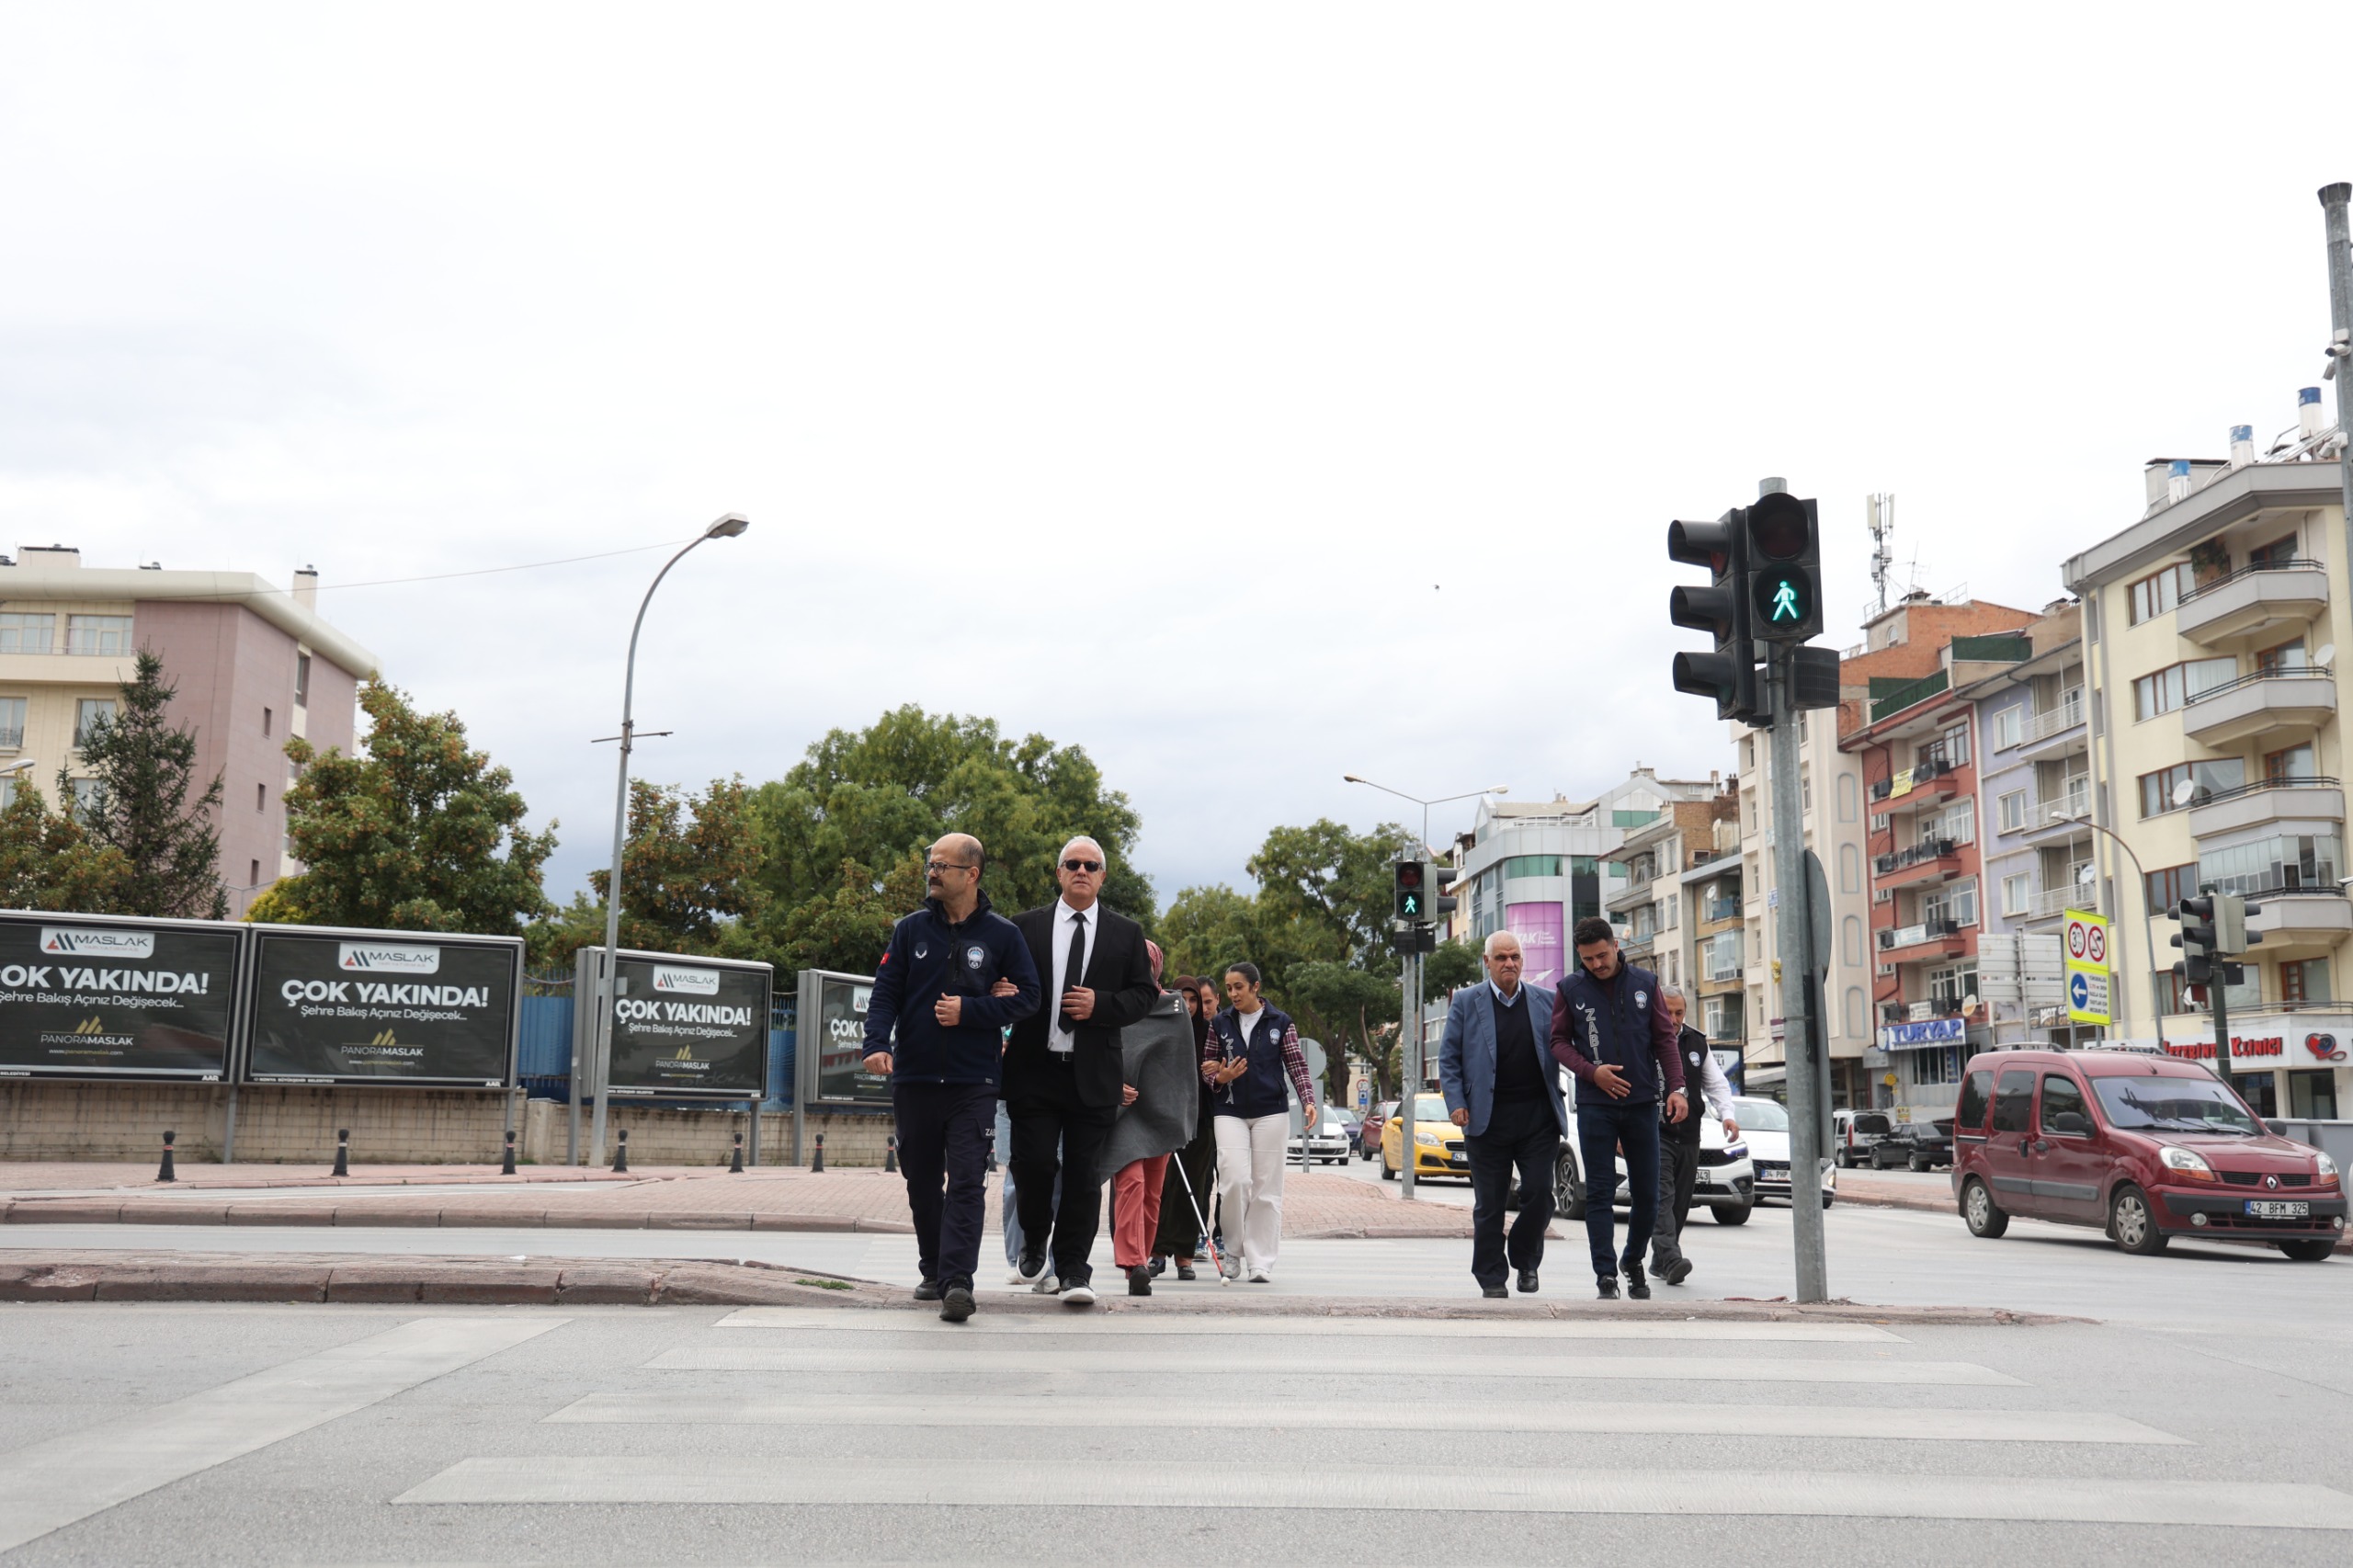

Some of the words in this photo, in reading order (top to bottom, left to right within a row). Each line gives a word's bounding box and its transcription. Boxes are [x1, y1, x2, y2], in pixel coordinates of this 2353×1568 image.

[74, 934, 149, 947] MASLAK
[369, 951, 435, 963] MASLAK
[0, 965, 52, 988] OK
[59, 967, 210, 994] YAKINDA!
[673, 974, 716, 985] MASLAK
[36, 992, 72, 1005] Bakış
[73, 994, 110, 1006] Açınız
[281, 979, 350, 1007] ÇOK
[355, 983, 489, 1007] YAKINDA!
[301, 1005, 335, 1017] Şehre
[336, 1006, 368, 1019] Bakış
[369, 1007, 402, 1020] Açınız
[615, 999, 661, 1024] ÇOK
[665, 1002, 752, 1026] YAKINDA!
[628, 1022, 652, 1033] Şehre
[652, 1024, 674, 1036] Bakış
[830, 1017, 858, 1040] ÇOK
[1891, 1018, 1962, 1042] TURYAP
[40, 1034, 134, 1046] PANORAMASLAK
[341, 1045, 424, 1057] PANORAMASLAK
[655, 1060, 710, 1071] PANORAMASLAK
[2251, 1202, 2262, 1214] 42
[2268, 1203, 2286, 1214] BFM
[2291, 1203, 2308, 1214] 325
